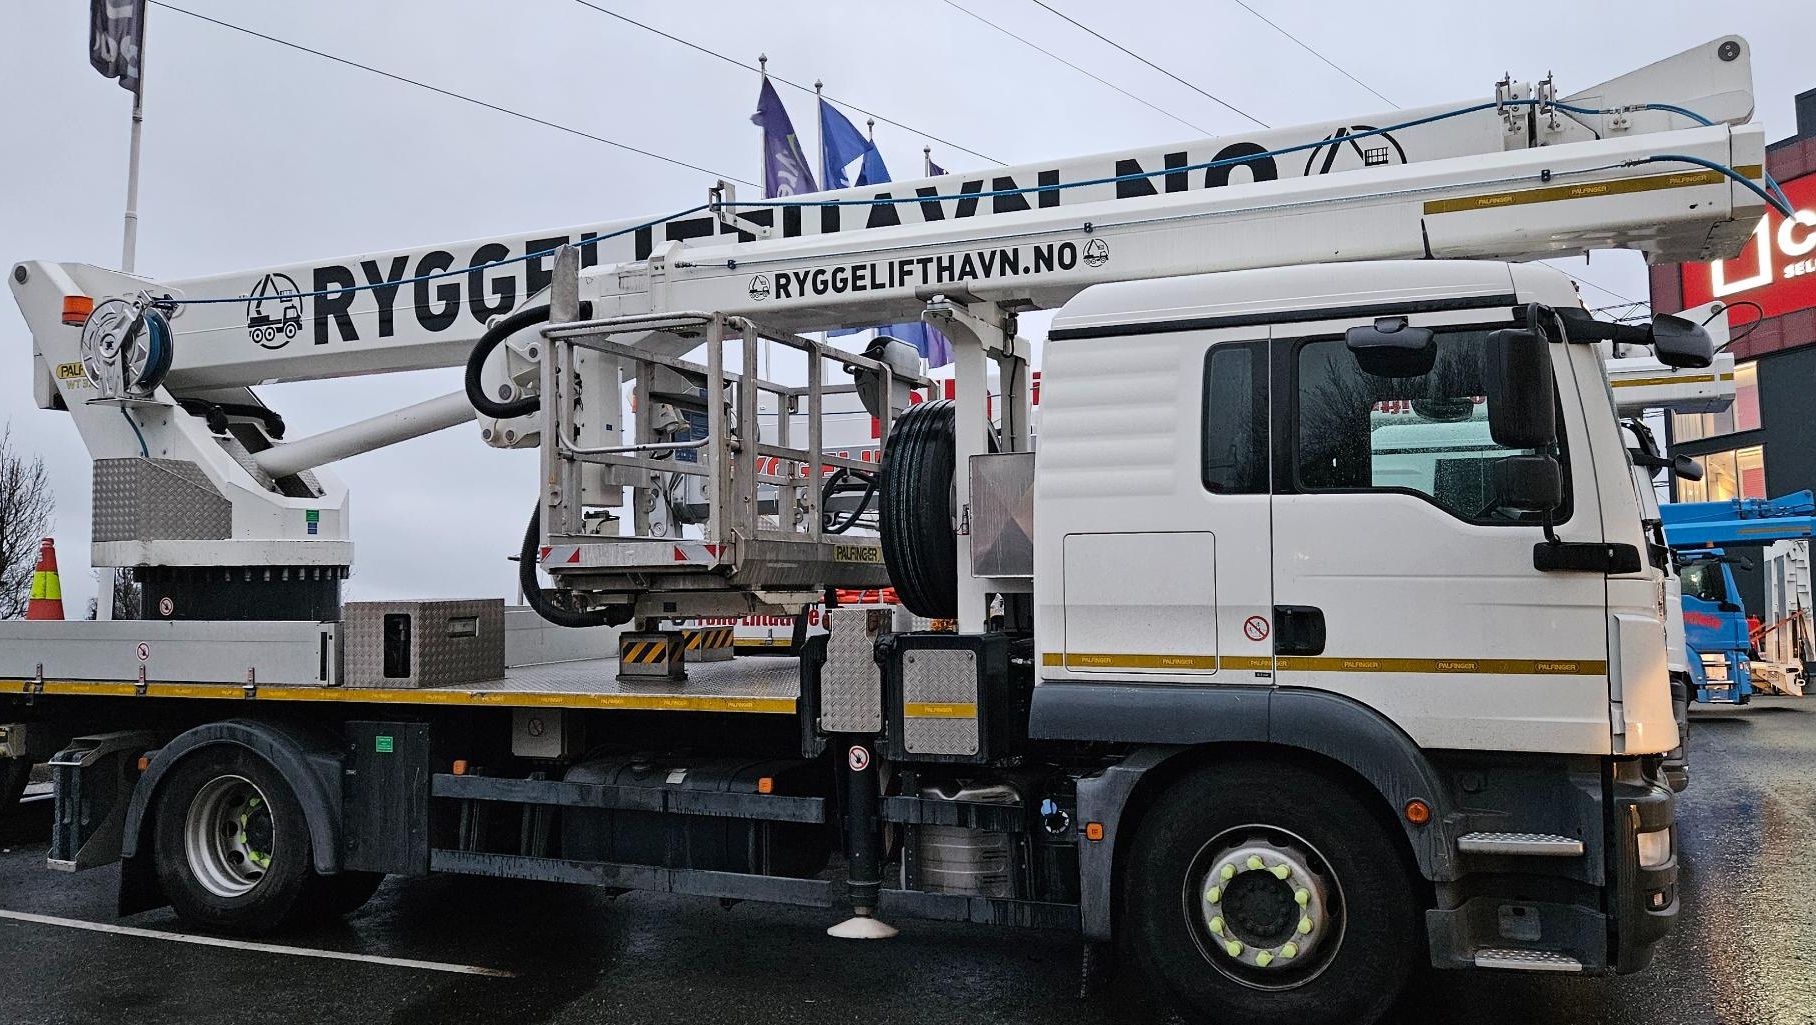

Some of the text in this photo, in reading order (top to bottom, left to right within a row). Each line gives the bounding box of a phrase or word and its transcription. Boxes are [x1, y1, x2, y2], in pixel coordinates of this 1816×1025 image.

[775, 242, 1078, 300] RYGGELIFTHAVN.NO
[1783, 259, 1816, 278] SEL
[836, 546, 878, 562] PALFINGER
